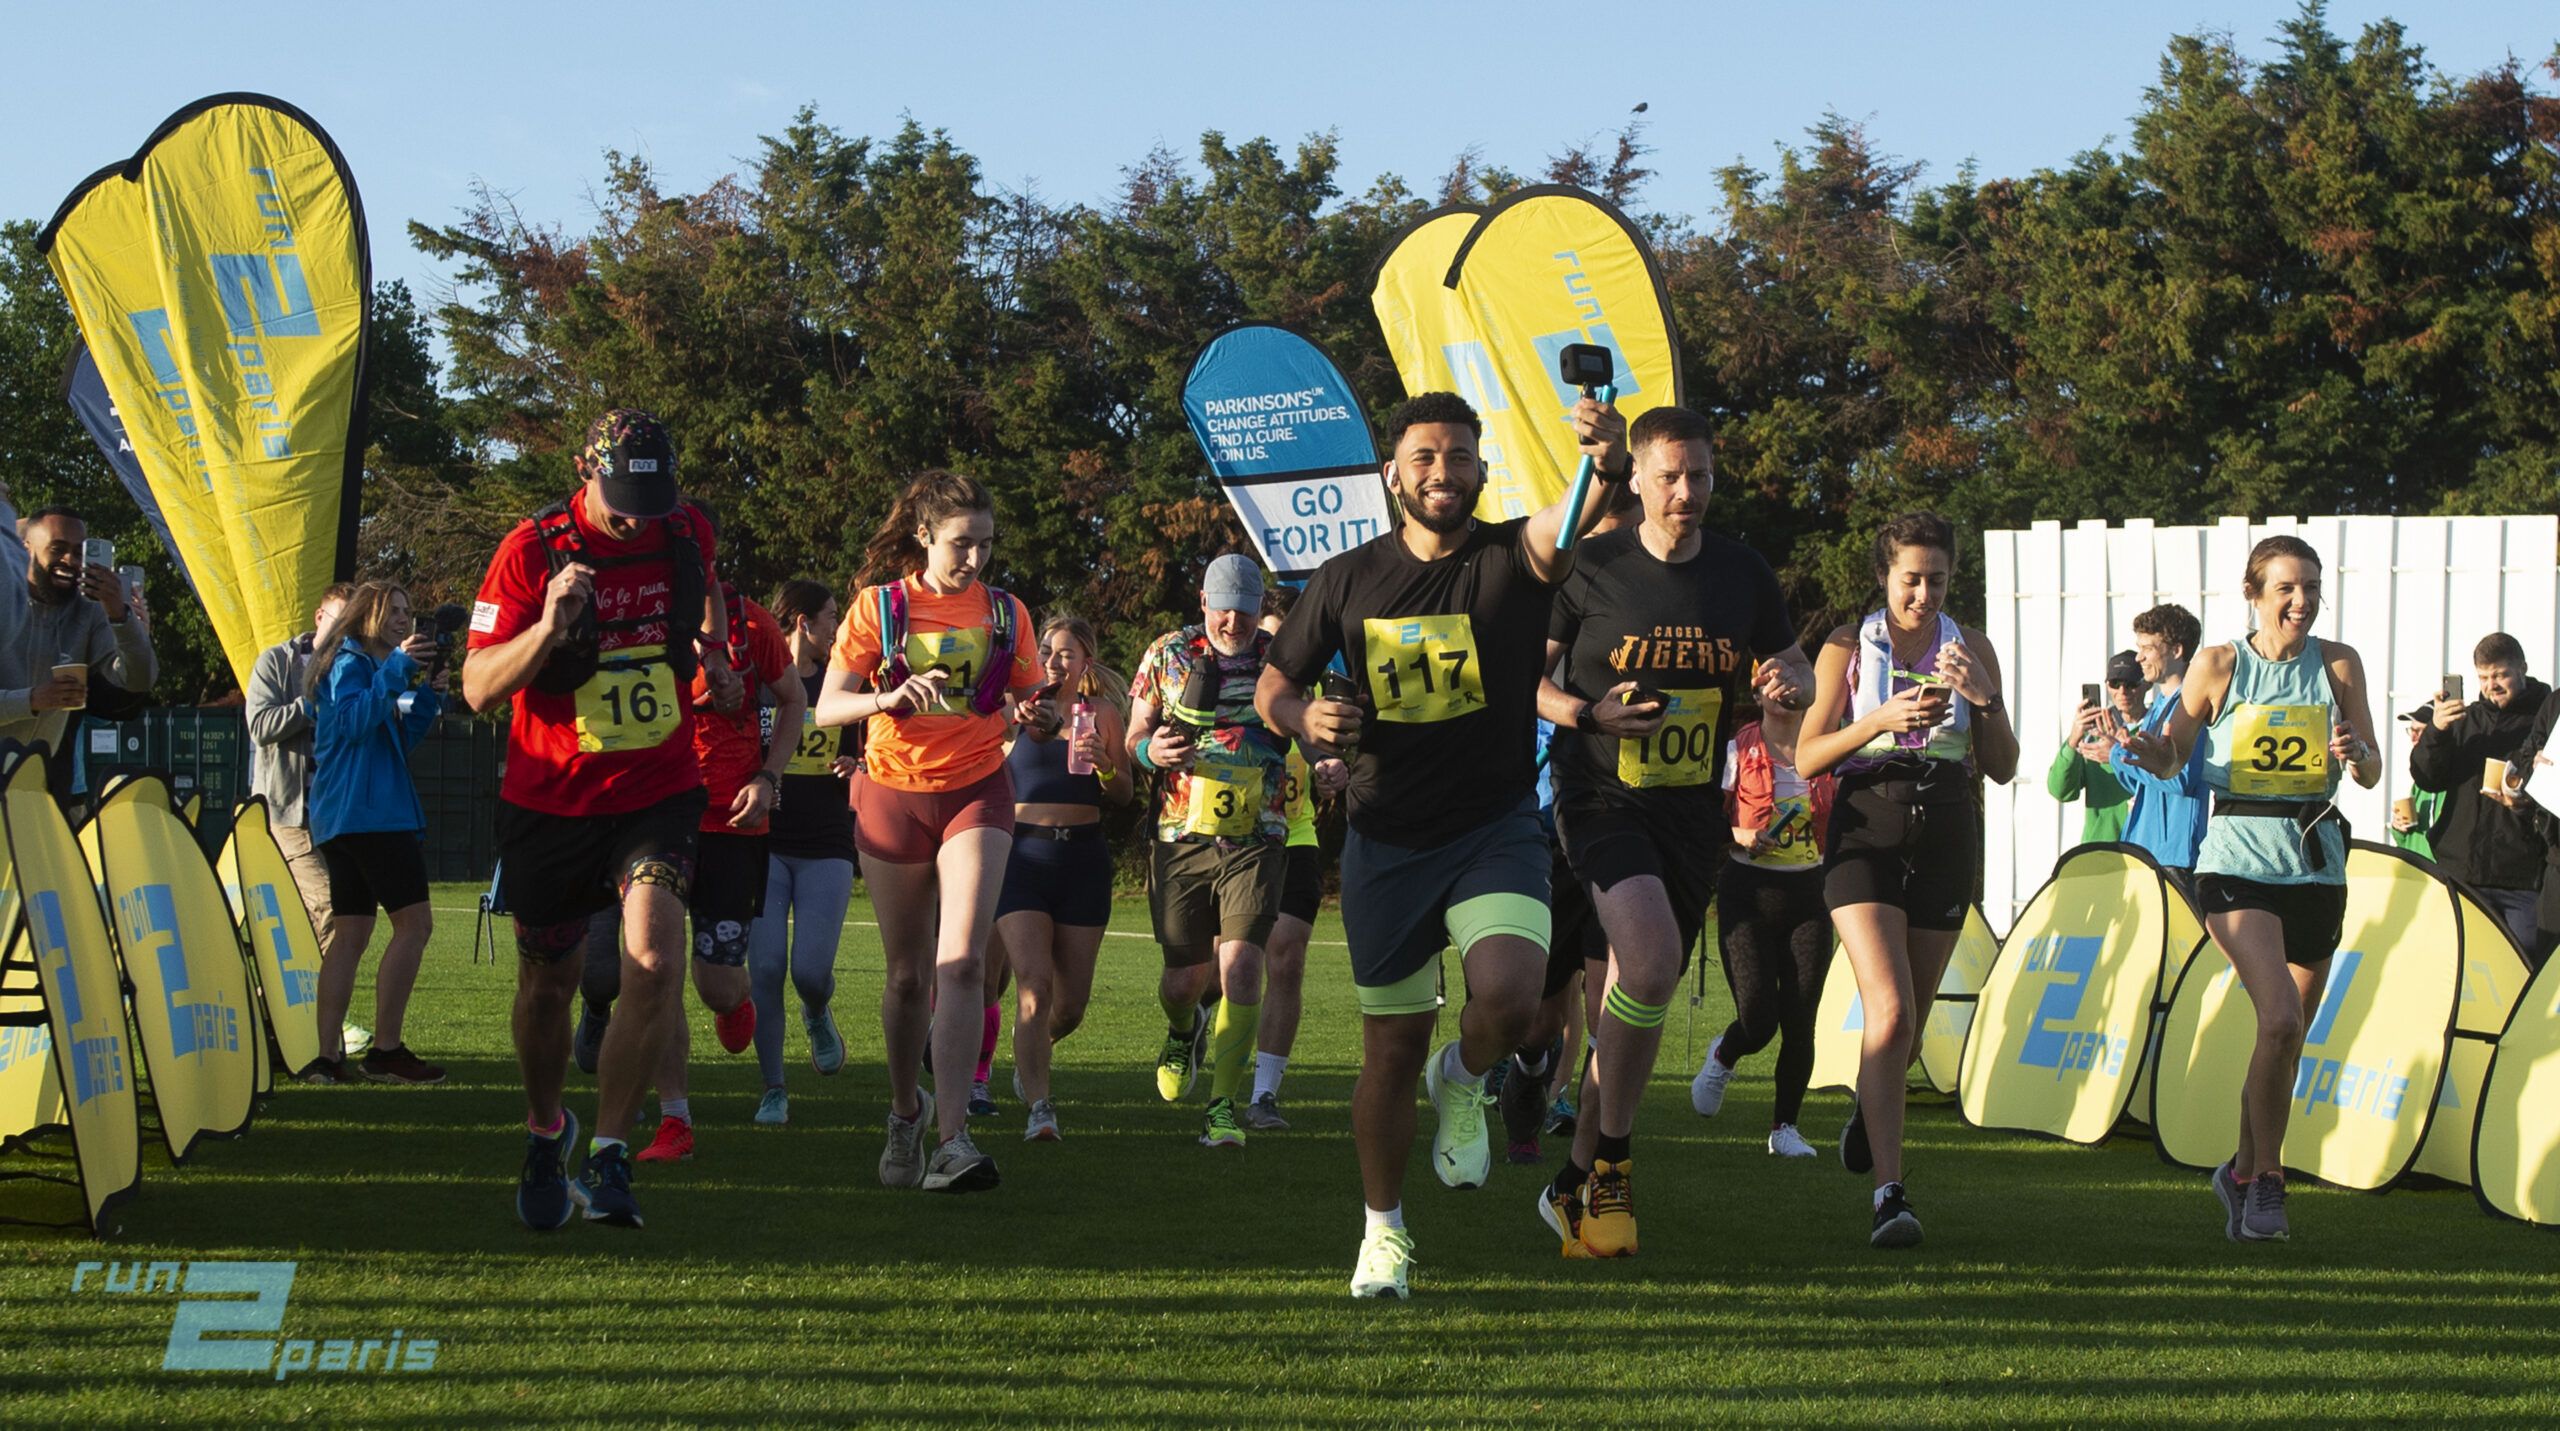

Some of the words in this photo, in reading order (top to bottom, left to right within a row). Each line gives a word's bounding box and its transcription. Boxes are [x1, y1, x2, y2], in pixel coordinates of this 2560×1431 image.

[1553, 250, 1605, 322] run
[226, 343, 293, 459] paris
[1207, 415, 1267, 433] CHANGE
[1269, 405, 1350, 427] ATTITUDES.
[1210, 434, 1242, 448] FIND
[1244, 432, 1255, 445] A
[1255, 427, 1297, 442] CURE.
[1212, 447, 1244, 463] JOIN
[1246, 445, 1269, 460] US.
[1291, 484, 1343, 517] GO
[1263, 523, 1331, 557] FOR
[1378, 650, 1468, 699] 117
[1610, 635, 1739, 675] TIGERS
[601, 681, 658, 726] 16
[2251, 735, 2308, 772] 32
[1213, 789, 1236, 819] 3
[2018, 936, 2104, 1068] 2
[190, 990, 239, 1077] paris
[2057, 1024, 2128, 1082] paris
[2304, 1058, 2410, 1121] paris
